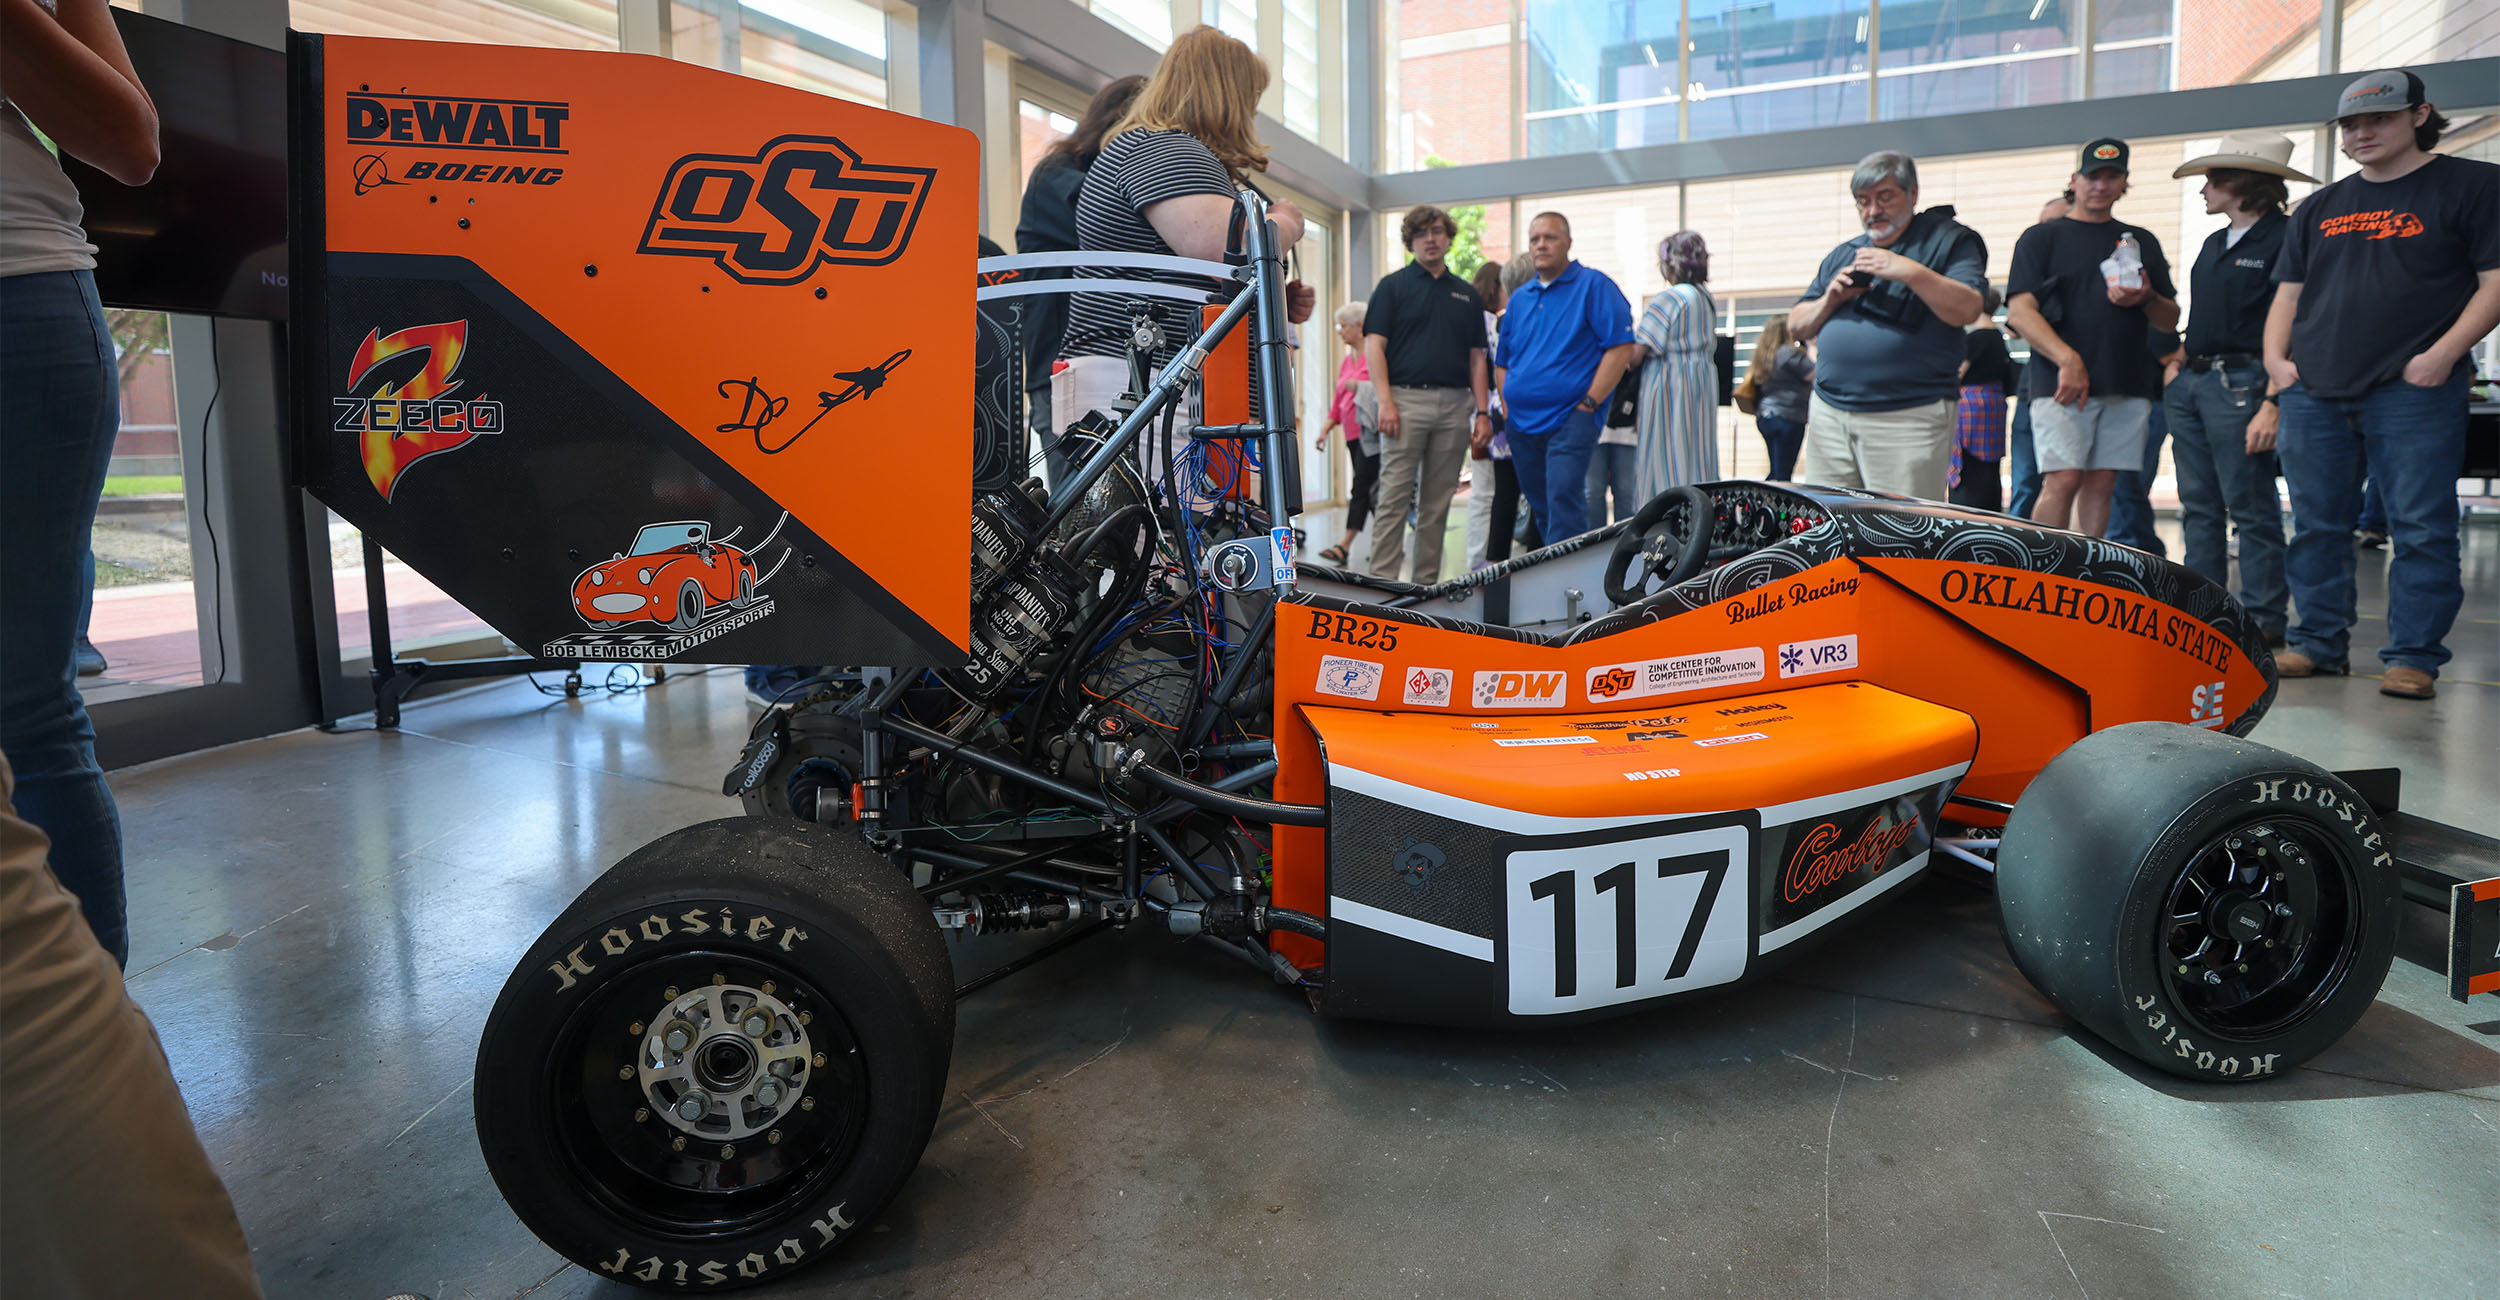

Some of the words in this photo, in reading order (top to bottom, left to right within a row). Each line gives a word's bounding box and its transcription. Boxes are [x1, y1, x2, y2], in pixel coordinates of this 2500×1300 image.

[404, 161, 564, 186] BOEING
[636, 133, 938, 287] OSU
[2319, 209, 2394, 230] COWBOY
[2324, 219, 2392, 237] RACING
[261, 271, 288, 287] No
[333, 397, 504, 435] ZEECO
[2084, 541, 2146, 580] FIRING
[1014, 586, 1051, 629] DANIEL'S
[1726, 592, 1786, 625] Bullet
[1789, 577, 1861, 607] Racing
[545, 645, 577, 657] BOB
[582, 645, 665, 658] LEMBCKE
[665, 604, 775, 657] MOTORSPORTS
[1306, 610, 1400, 652] BR25
[1940, 569, 2159, 641] OKLAHOMA
[2163, 615, 2233, 674] STATE
[963, 658, 992, 684] 25
[986, 648, 1010, 675] State
[1354, 661, 1369, 669] TIRE
[1648, 663, 1668, 673] ZINK
[1670, 659, 1703, 671] CENTER
[1704, 656, 1721, 666] FOR
[1648, 668, 1703, 682] COMPETITIVE
[1705, 661, 1756, 675] INNOVATION
[1810, 643, 1848, 665] VR3
[1495, 673, 1564, 698] DW
[1589, 667, 1637, 698] OSU
[2191, 681, 2225, 719] SAE
[1623, 771, 1648, 781] NO
[1645, 768, 1681, 779] STEP
[2251, 778, 2394, 869] Hoosier
[1784, 813, 1920, 903] Cowboys
[1529, 848, 1731, 998] 117
[548, 906, 809, 995] Hoosier
[2135, 995, 2281, 1078] Hoosier
[599, 1201, 856, 1288] Hoosier
